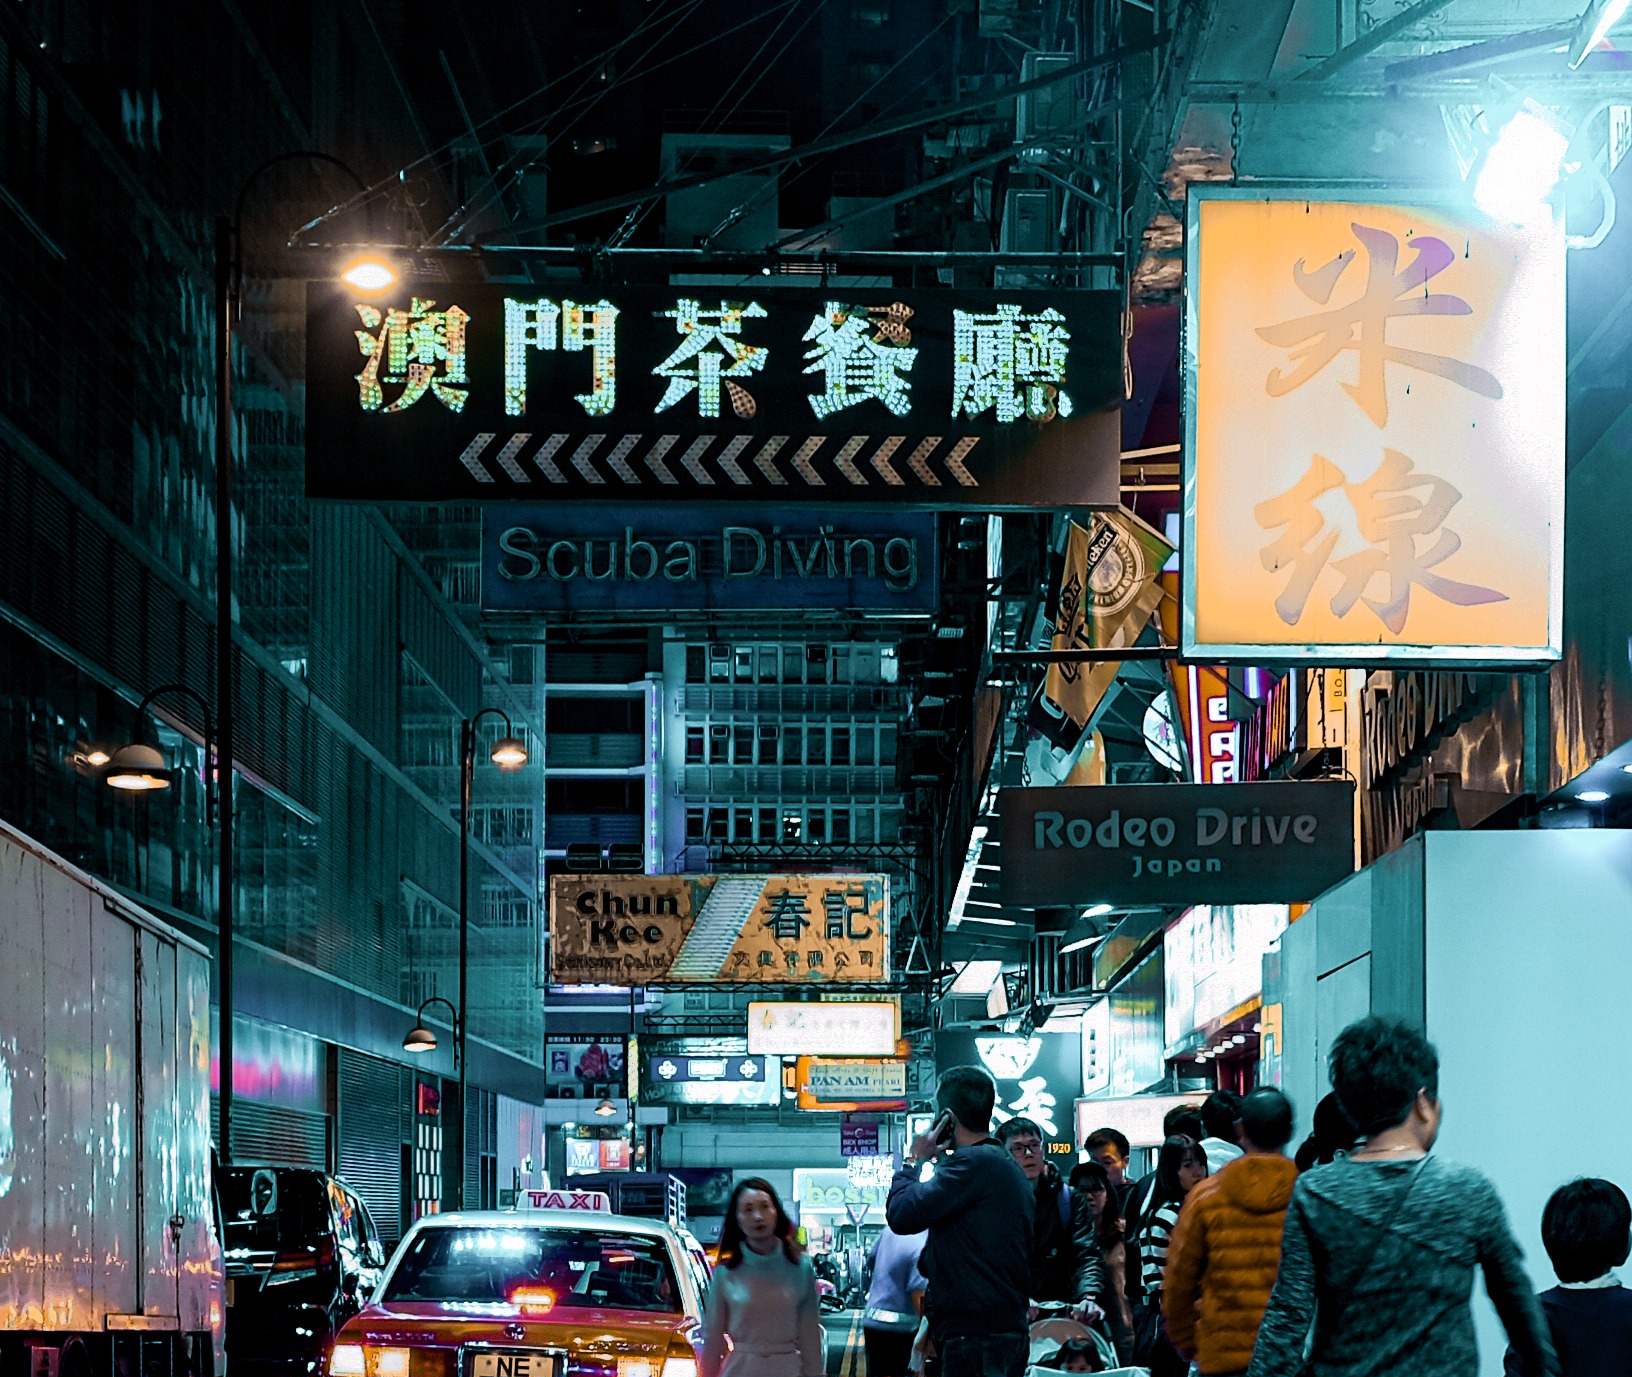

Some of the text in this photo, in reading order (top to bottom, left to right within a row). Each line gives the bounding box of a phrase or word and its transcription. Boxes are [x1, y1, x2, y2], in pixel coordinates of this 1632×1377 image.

[353, 297, 1074, 424] 澳門茶餐廳
[1254, 222, 1510, 635] 米線
[497, 525, 919, 592] Scuba Diving
[1033, 806, 1319, 851] Rodeo Drive
[1131, 855, 1223, 879] Japan
[576, 887, 679, 916] Chun
[764, 889, 874, 942] 春記
[590, 920, 663, 947] Kee
[810, 1076, 841, 1086] PAN
[844, 1076, 869, 1086] AM
[527, 1191, 603, 1211] TAXI
[806, 1177, 880, 1204] boss
[497, 1357, 531, 1377] NE
